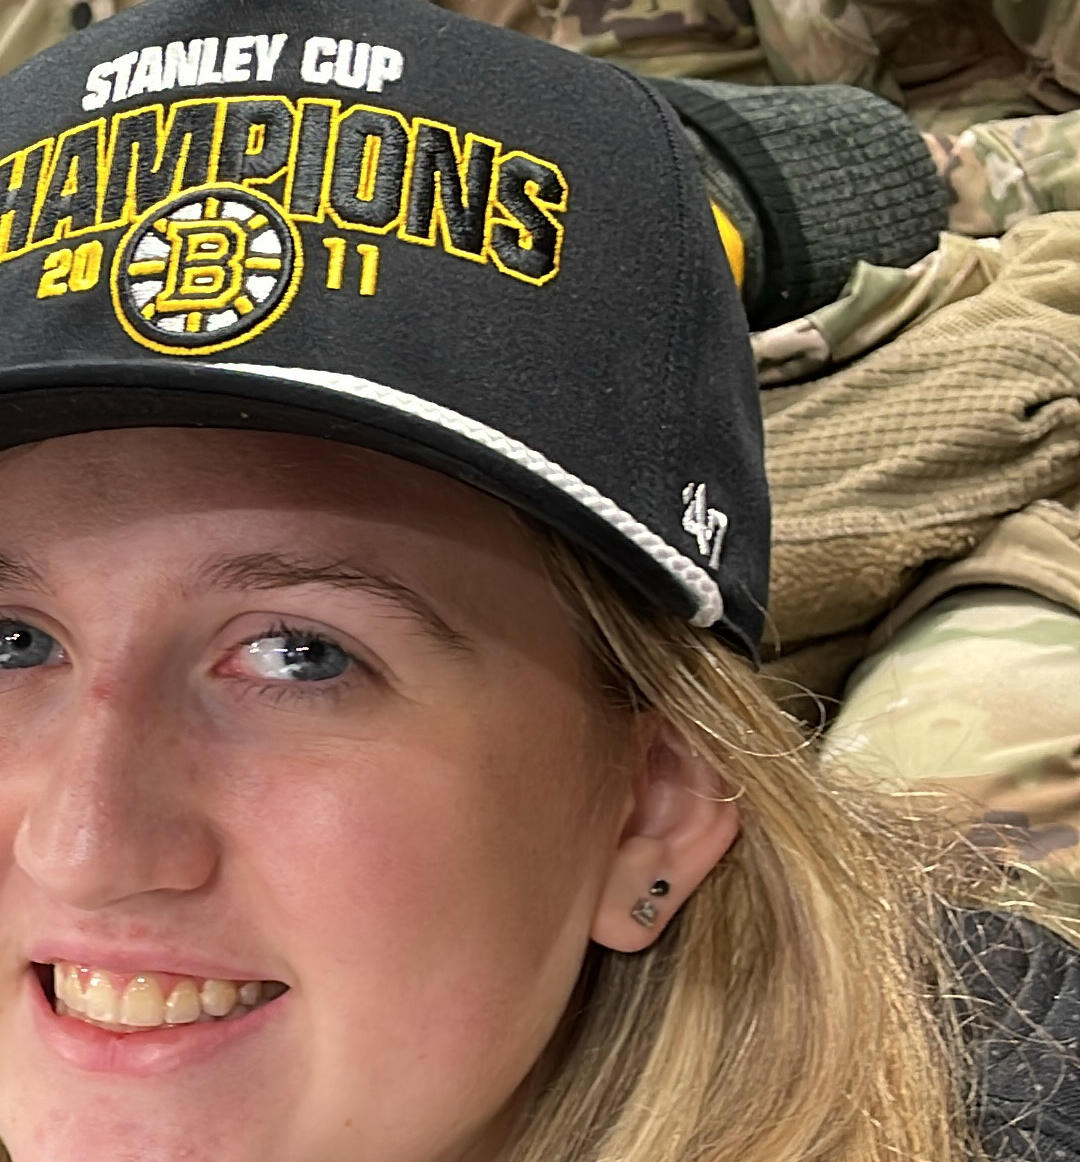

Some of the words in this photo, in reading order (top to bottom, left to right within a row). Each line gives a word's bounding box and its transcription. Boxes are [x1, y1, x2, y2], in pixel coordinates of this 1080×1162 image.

[82, 34, 287, 111] STANLEY
[301, 37, 404, 93] CUP
[36, 240, 103, 298] 20
[156, 218, 248, 312] B
[322, 237, 379, 296] 11
